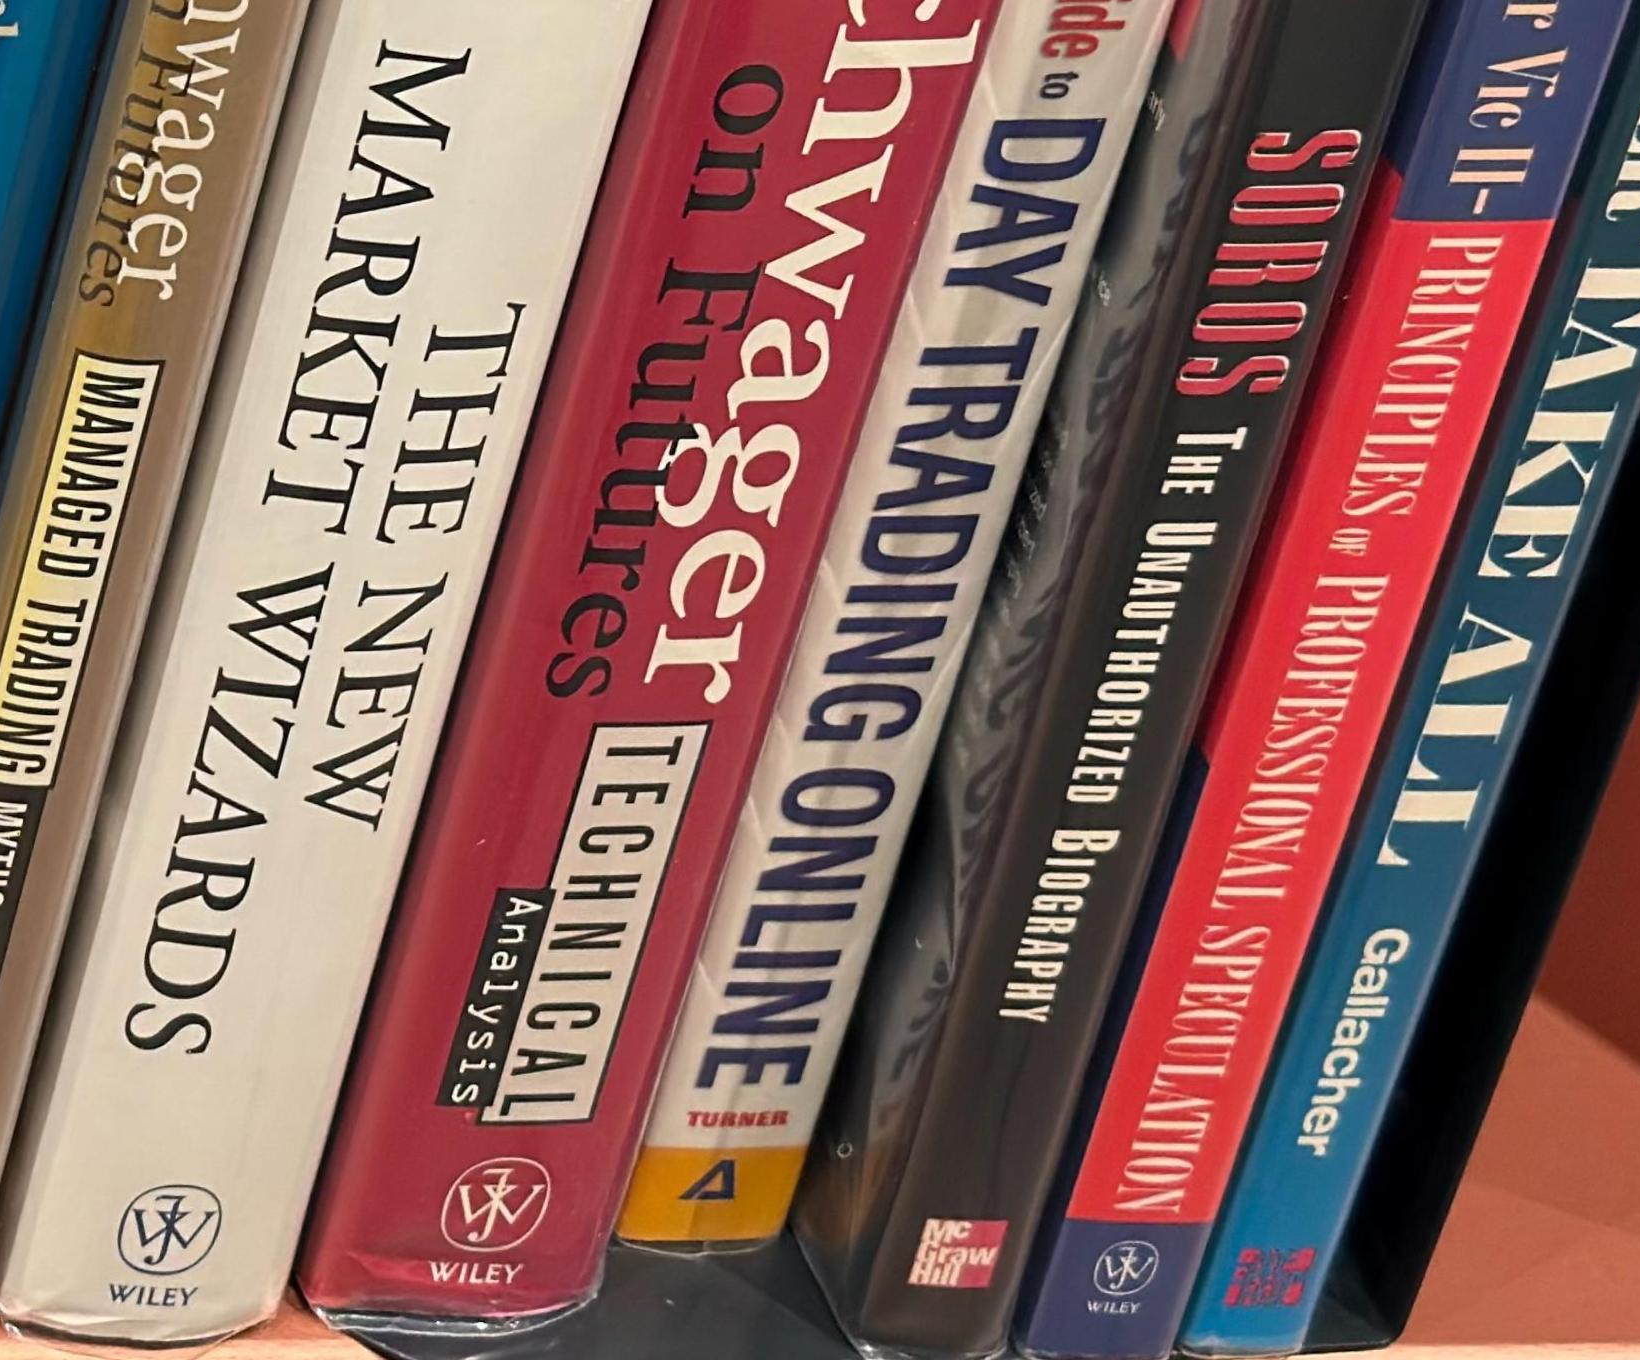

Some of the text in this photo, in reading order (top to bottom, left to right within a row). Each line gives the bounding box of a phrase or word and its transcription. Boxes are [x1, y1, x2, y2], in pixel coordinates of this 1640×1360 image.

[944, 117, 1107, 307] DAY
[1041, 70, 1073, 98] to
[1467, 47, 1568, 130] Vic
[544, 63, 785, 700] on Futures
[1175, 126, 1363, 398] SOROS
[1341, 232, 1505, 519] PRINCIPLES
[43, 368, 146, 580] MANAGED
[124, 38, 473, 1057] MARKET WIZARDS
[304, 302, 527, 834] THE NEW
[802, 321, 1048, 745] TRADING
[1161, 428, 1249, 497] THE
[1066, 517, 1216, 807] UNAUTHORIZED
[1200, 573, 1392, 910] PROFESSIONAL
[1380, 608, 1535, 869] ALL
[452, 894, 525, 1104] Analysis
[500, 735, 682, 1121] TECHNICAL
[695, 765, 894, 1090] ONLINE
[998, 827, 1122, 1024] BIOGRAPHY
[1296, 927, 1410, 1158] Gallacher
[687, 1109, 789, 1129] TURNER
[1115, 923, 1272, 1214] SPECULATION
[110, 1283, 199, 1309] WILEY
[430, 1260, 524, 1285] WILEY
